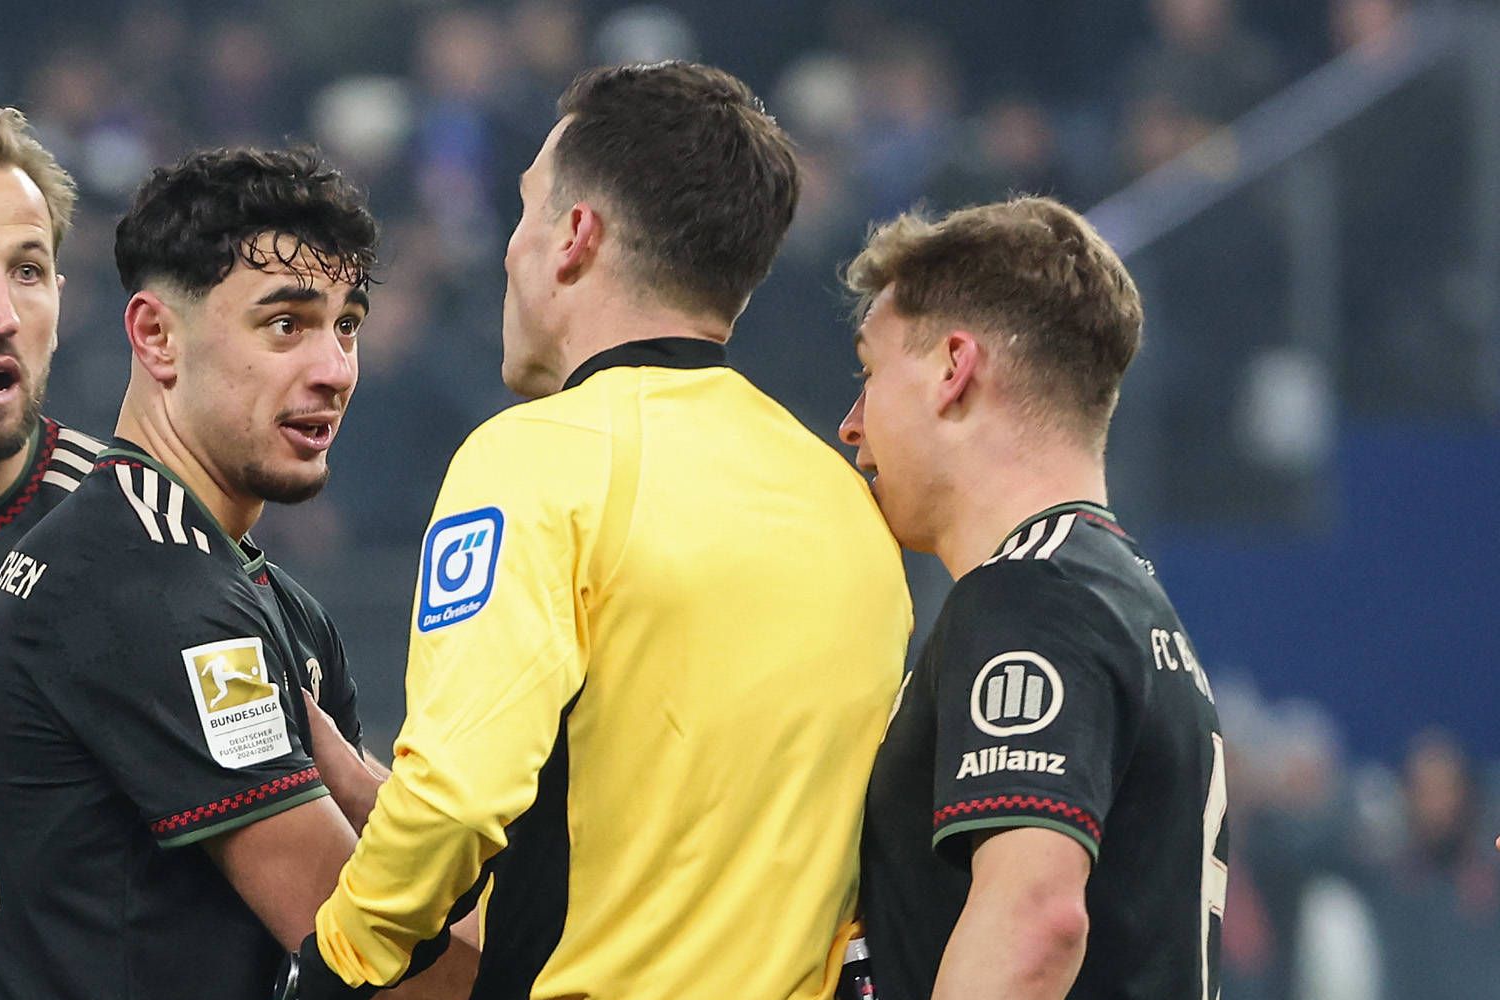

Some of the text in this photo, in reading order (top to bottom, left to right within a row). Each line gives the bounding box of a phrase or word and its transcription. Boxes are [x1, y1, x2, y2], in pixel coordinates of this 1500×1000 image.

[423, 600, 482, 627] Das Örtliche
[210, 702, 278, 729] BUNDESLIGA
[219, 733, 283, 757] FUSSBALLMEISTER
[229, 727, 273, 746] DEUTSCHER
[237, 744, 274, 760] 2024/2025
[956, 745, 1066, 780] Allianz
